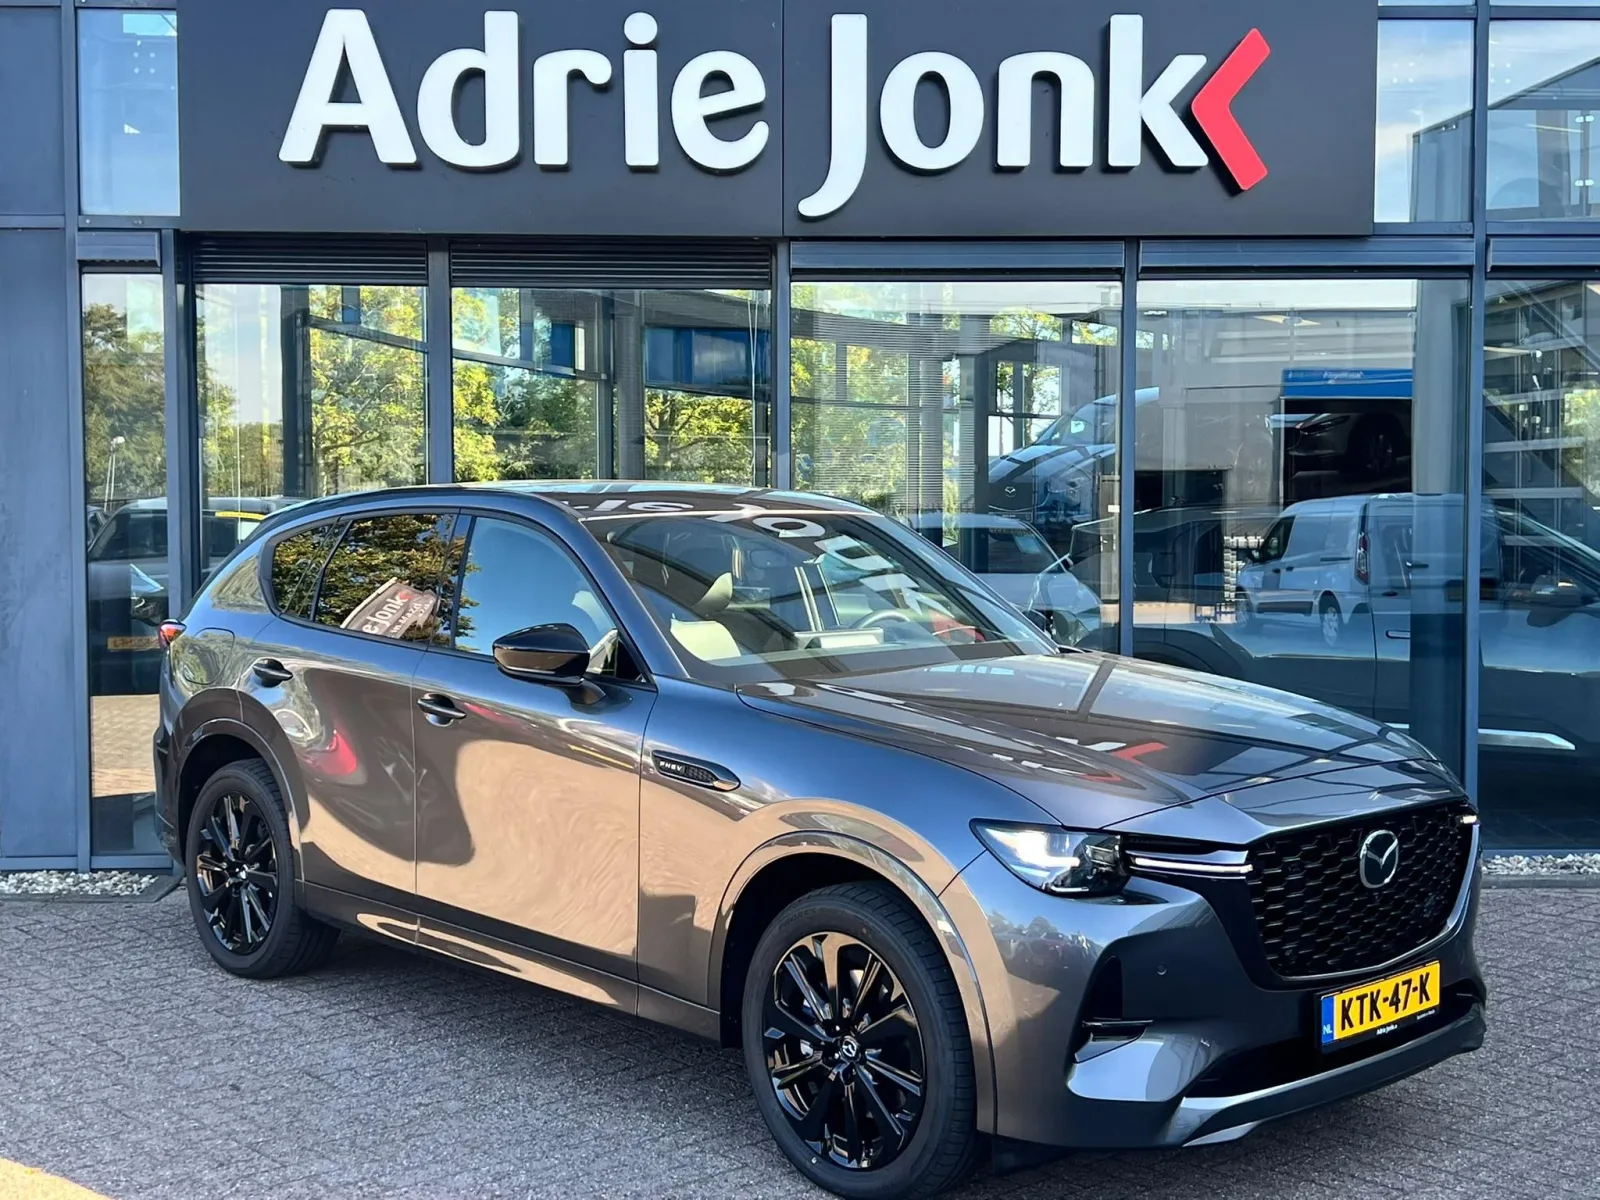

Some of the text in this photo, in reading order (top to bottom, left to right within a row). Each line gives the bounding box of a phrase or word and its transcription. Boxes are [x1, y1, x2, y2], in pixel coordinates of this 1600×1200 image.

[279, 9, 1208, 216] Adrie Jonk
[366, 594, 409, 627] Jonk
[1322, 972, 1430, 1035] NL KTK-47-K
